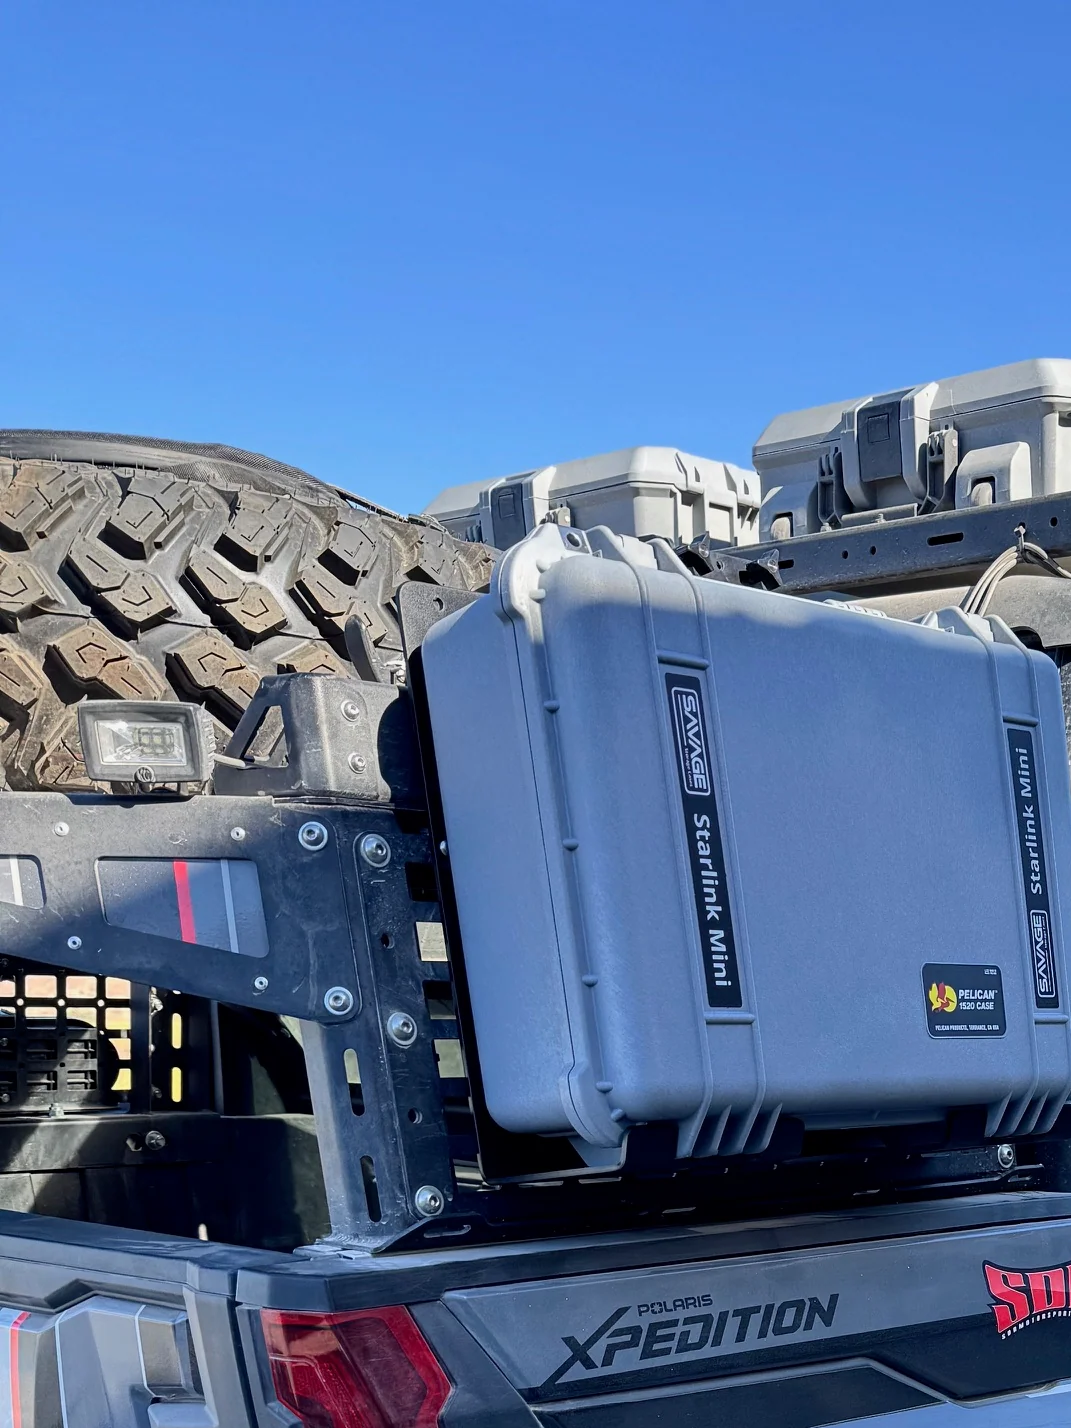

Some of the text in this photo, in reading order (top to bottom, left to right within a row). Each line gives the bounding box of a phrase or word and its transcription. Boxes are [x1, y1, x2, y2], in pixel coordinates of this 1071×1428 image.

[682, 694, 707, 790] SAVAGE
[1015, 747, 1043, 895] Starlink Mini
[694, 813, 732, 987] Starlink Mini
[958, 989, 996, 1000] PELICAN
[1032, 914, 1049, 993] SAVAGE
[958, 1001, 994, 1010] 1520 CASE
[542, 1293, 840, 1387] XPEDITION
[637, 1294, 714, 1317] POLARIS
